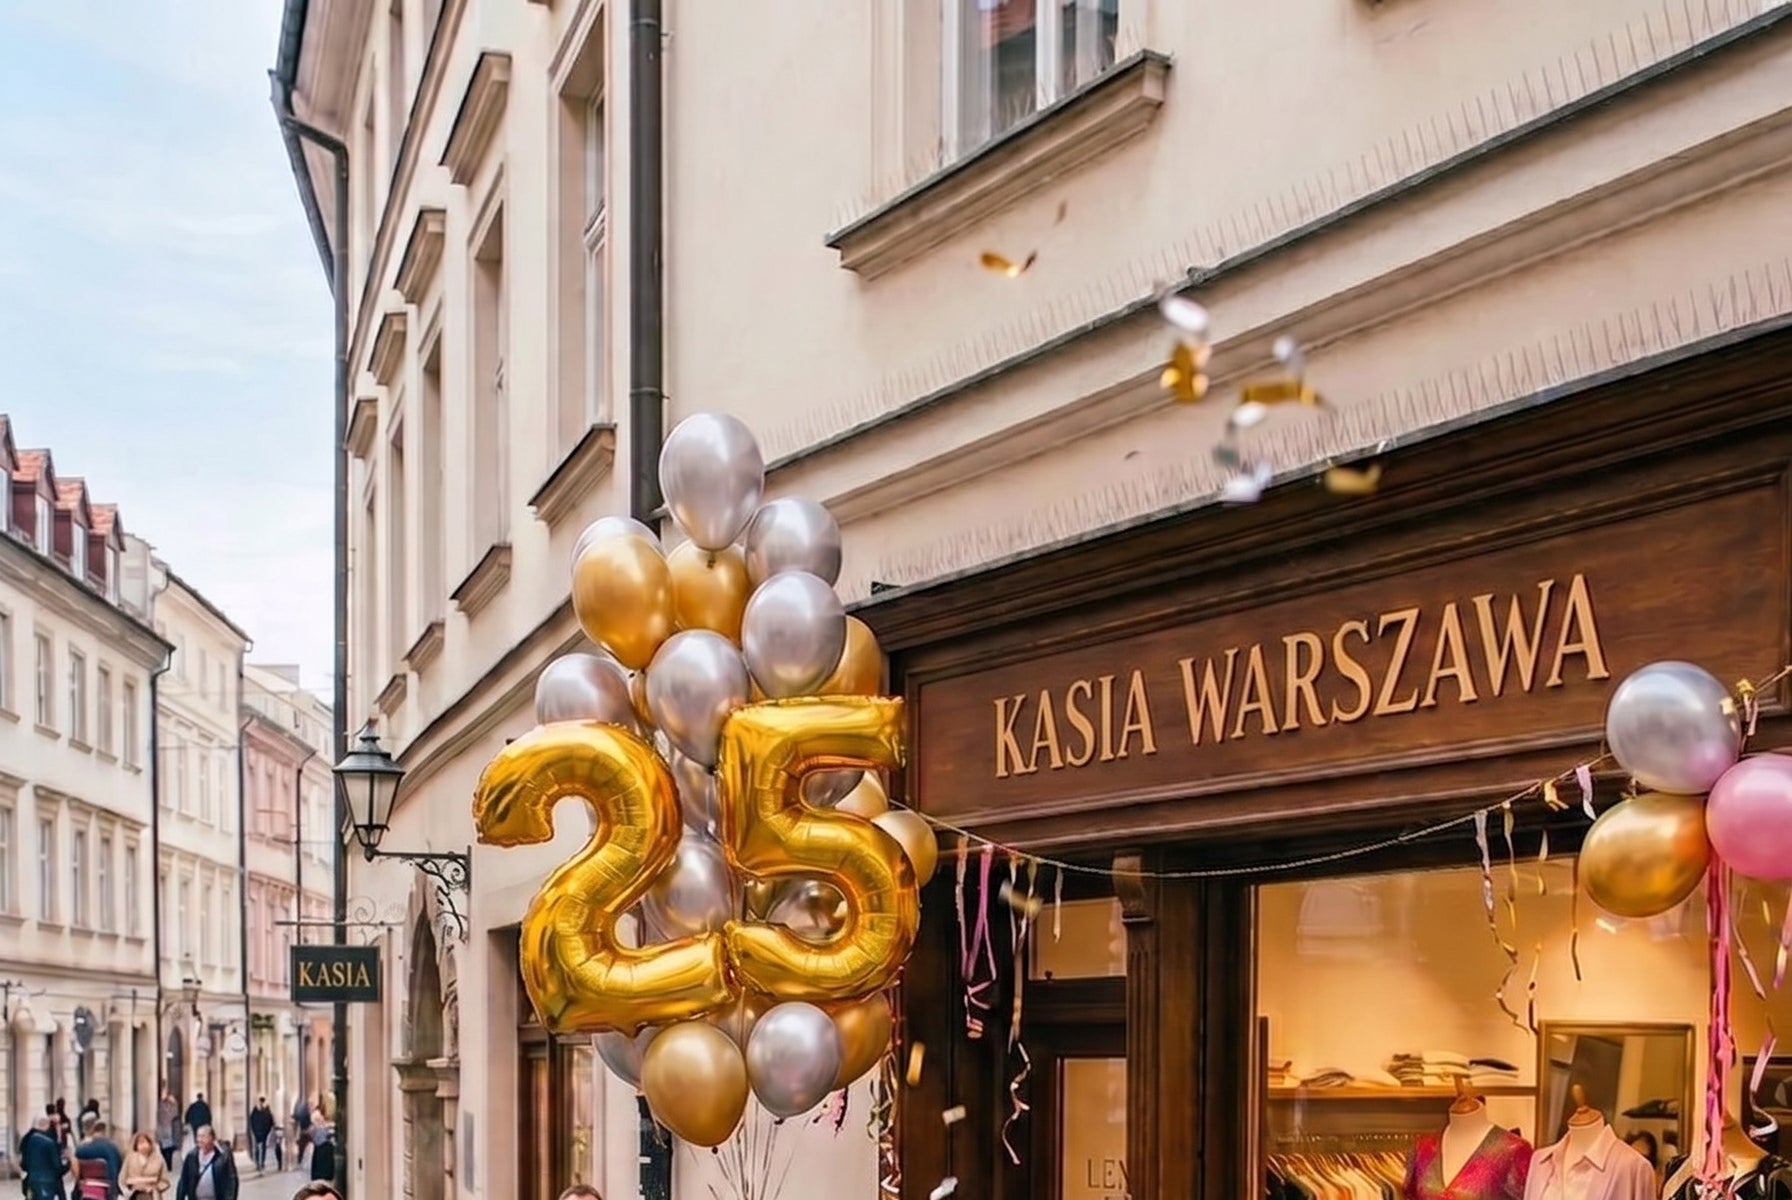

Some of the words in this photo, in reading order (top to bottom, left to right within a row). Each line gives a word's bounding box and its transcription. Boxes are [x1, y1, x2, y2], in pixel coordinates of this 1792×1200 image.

[994, 670, 1157, 778] KASIA
[1179, 573, 1610, 744] WARSZAWA
[472, 695, 921, 1038] 25
[299, 961, 371, 988] KASIA
